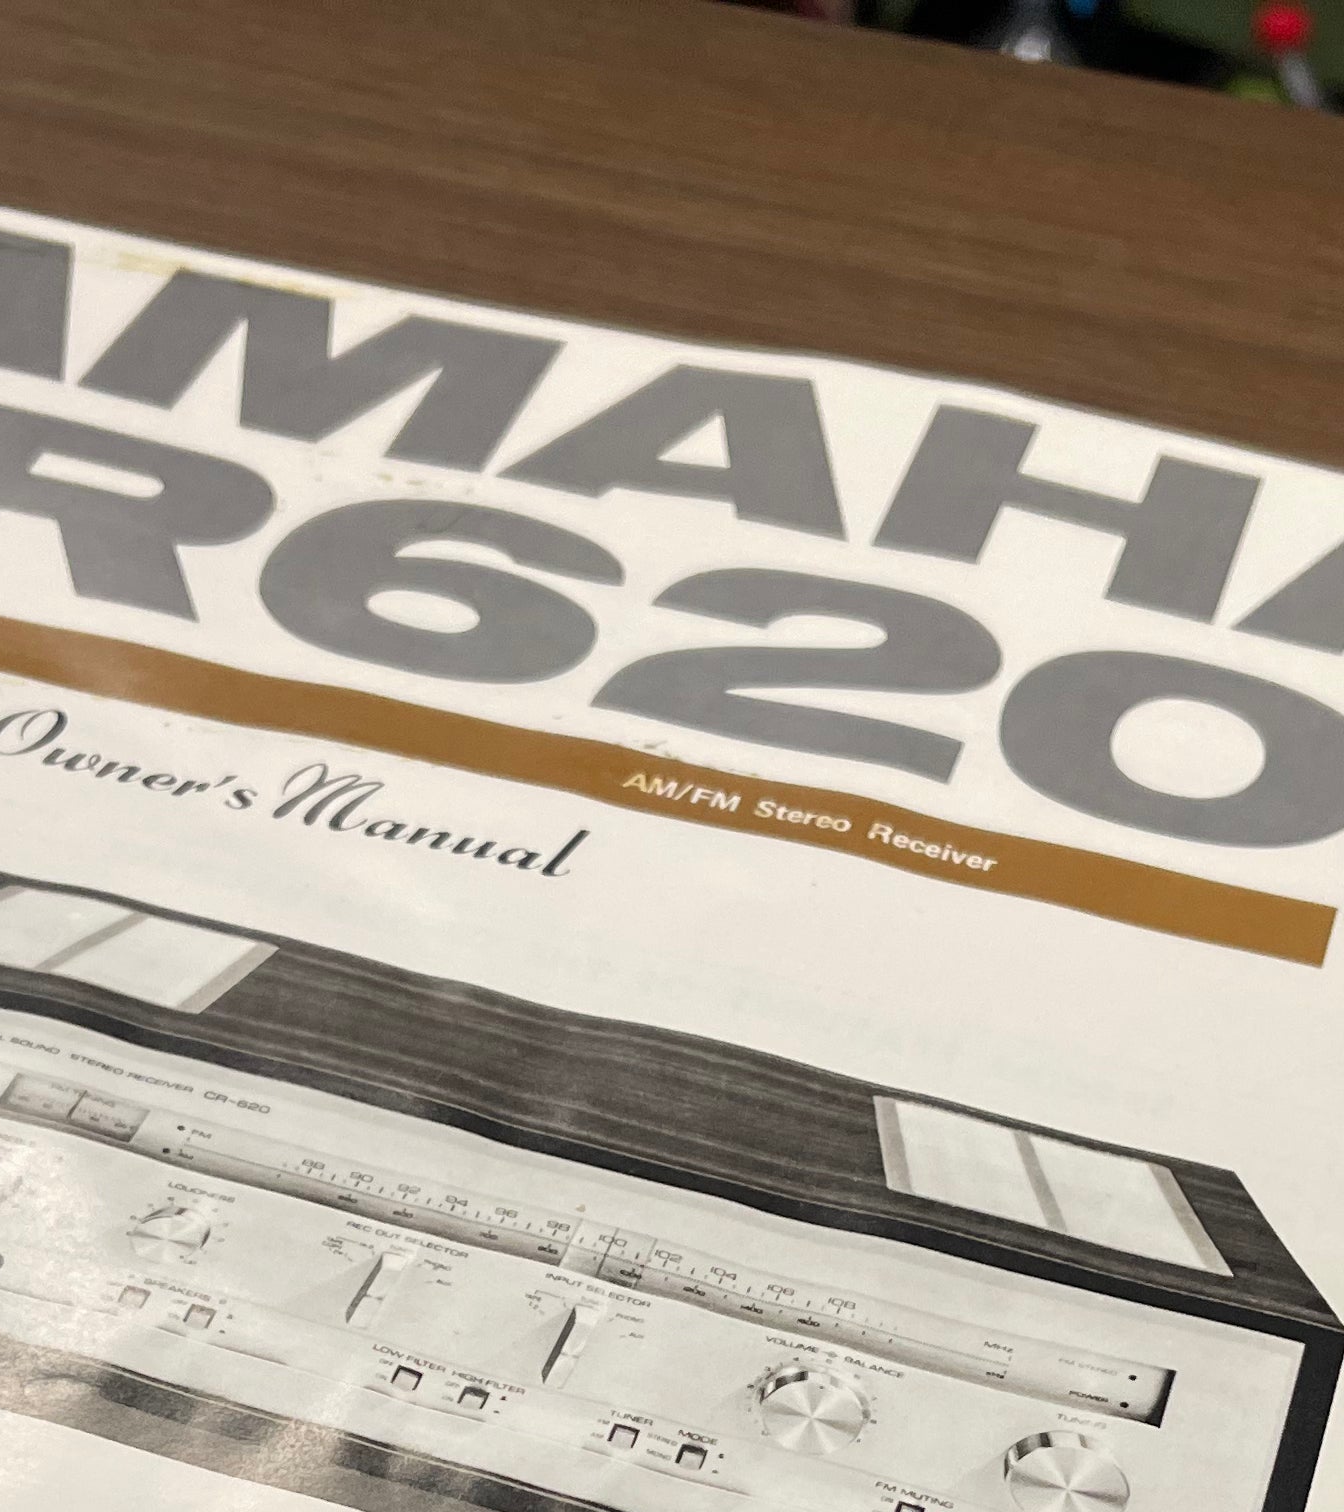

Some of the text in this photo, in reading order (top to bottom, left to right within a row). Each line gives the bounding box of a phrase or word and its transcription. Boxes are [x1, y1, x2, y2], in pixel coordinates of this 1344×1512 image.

[271, 762, 590, 879] Manual
[622, 772, 998, 873] AM/FM Stereo Receiver
[9, 1036, 62, 1056] SOUND
[69, 1052, 125, 1077] STEREO
[126, 1071, 195, 1094] RECEIVER
[202, 1089, 272, 1116] CR-620
[167, 1180, 237, 1204] LOUDNESS
[345, 1220, 372, 1233] REC
[374, 1228, 401, 1241] OUT
[404, 1235, 469, 1260] SELECTOR
[349, 1171, 374, 1184] 90
[444, 1194, 469, 1208] 94
[654, 1249, 684, 1264] 102
[709, 1265, 738, 1282] 104
[545, 1272, 583, 1289] INPUT
[586, 1284, 652, 1309] SELECTOR
[372, 1343, 447, 1373] LOW FILTER
[765, 1335, 905, 1379] VOLUME BALANCE
[451, 1369, 527, 1396] HIGH FILTER
[610, 1409, 654, 1427] TUNER
[677, 1428, 719, 1447] MODE
[874, 1480, 955, 1510] FM MUTING
